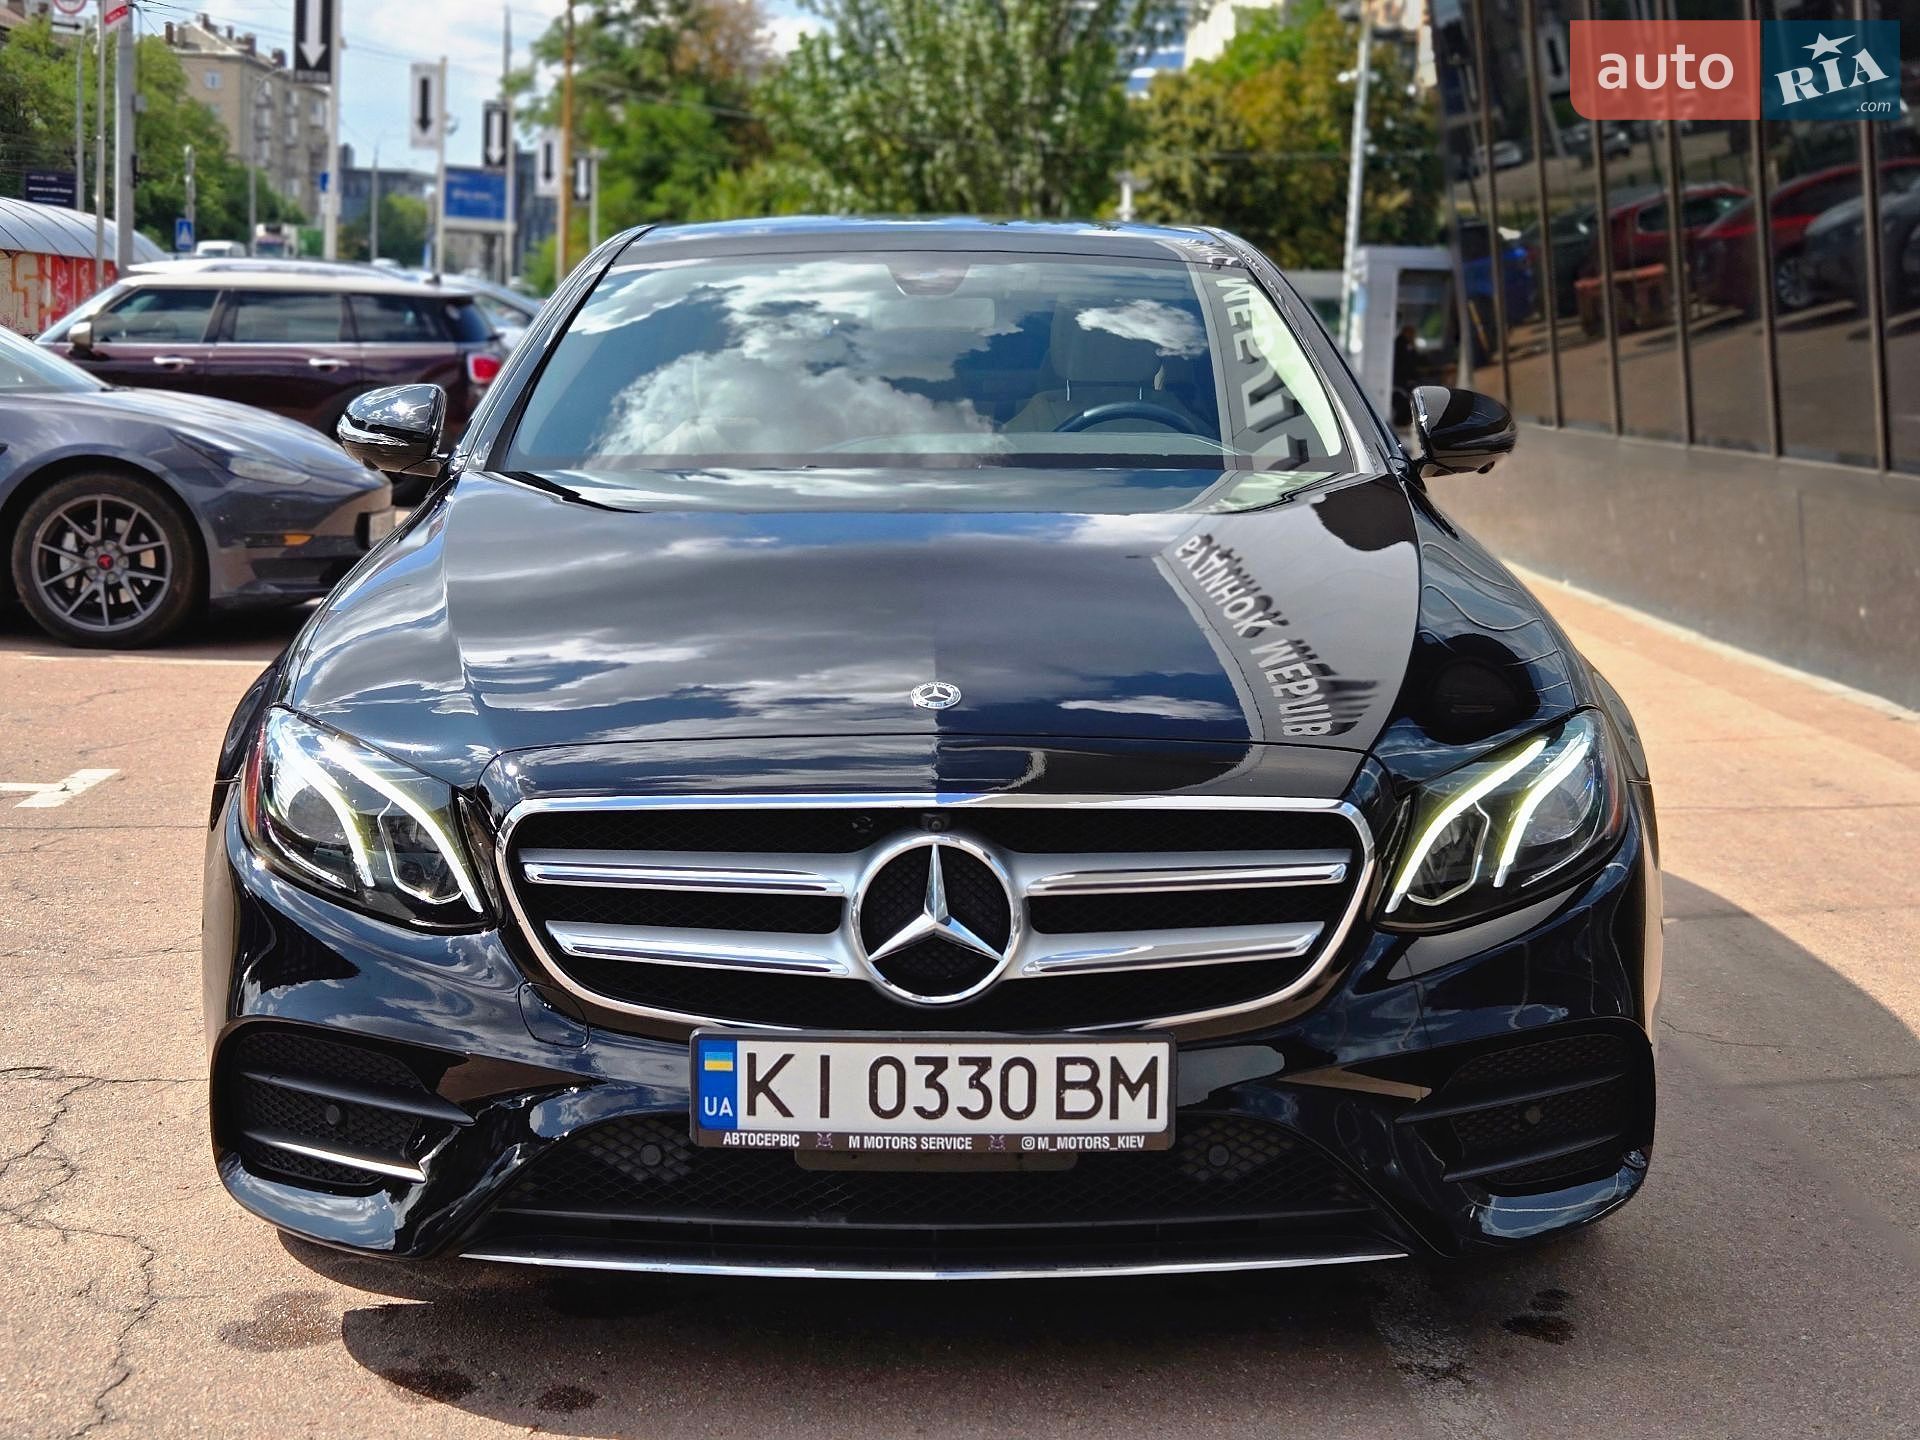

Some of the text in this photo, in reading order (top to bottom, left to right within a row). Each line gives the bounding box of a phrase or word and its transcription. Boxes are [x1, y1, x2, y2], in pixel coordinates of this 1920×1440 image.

[869, 1056, 1036, 1120] 0330
[1056, 1056, 1157, 1120] BM
[704, 1096, 733, 1117] UA
[723, 1133, 800, 1147] АВТОСЕРВІС
[848, 1137, 973, 1151] M MOTORS SERVICE
[1037, 1136, 1145, 1150] M_MOTORS_KIEV
